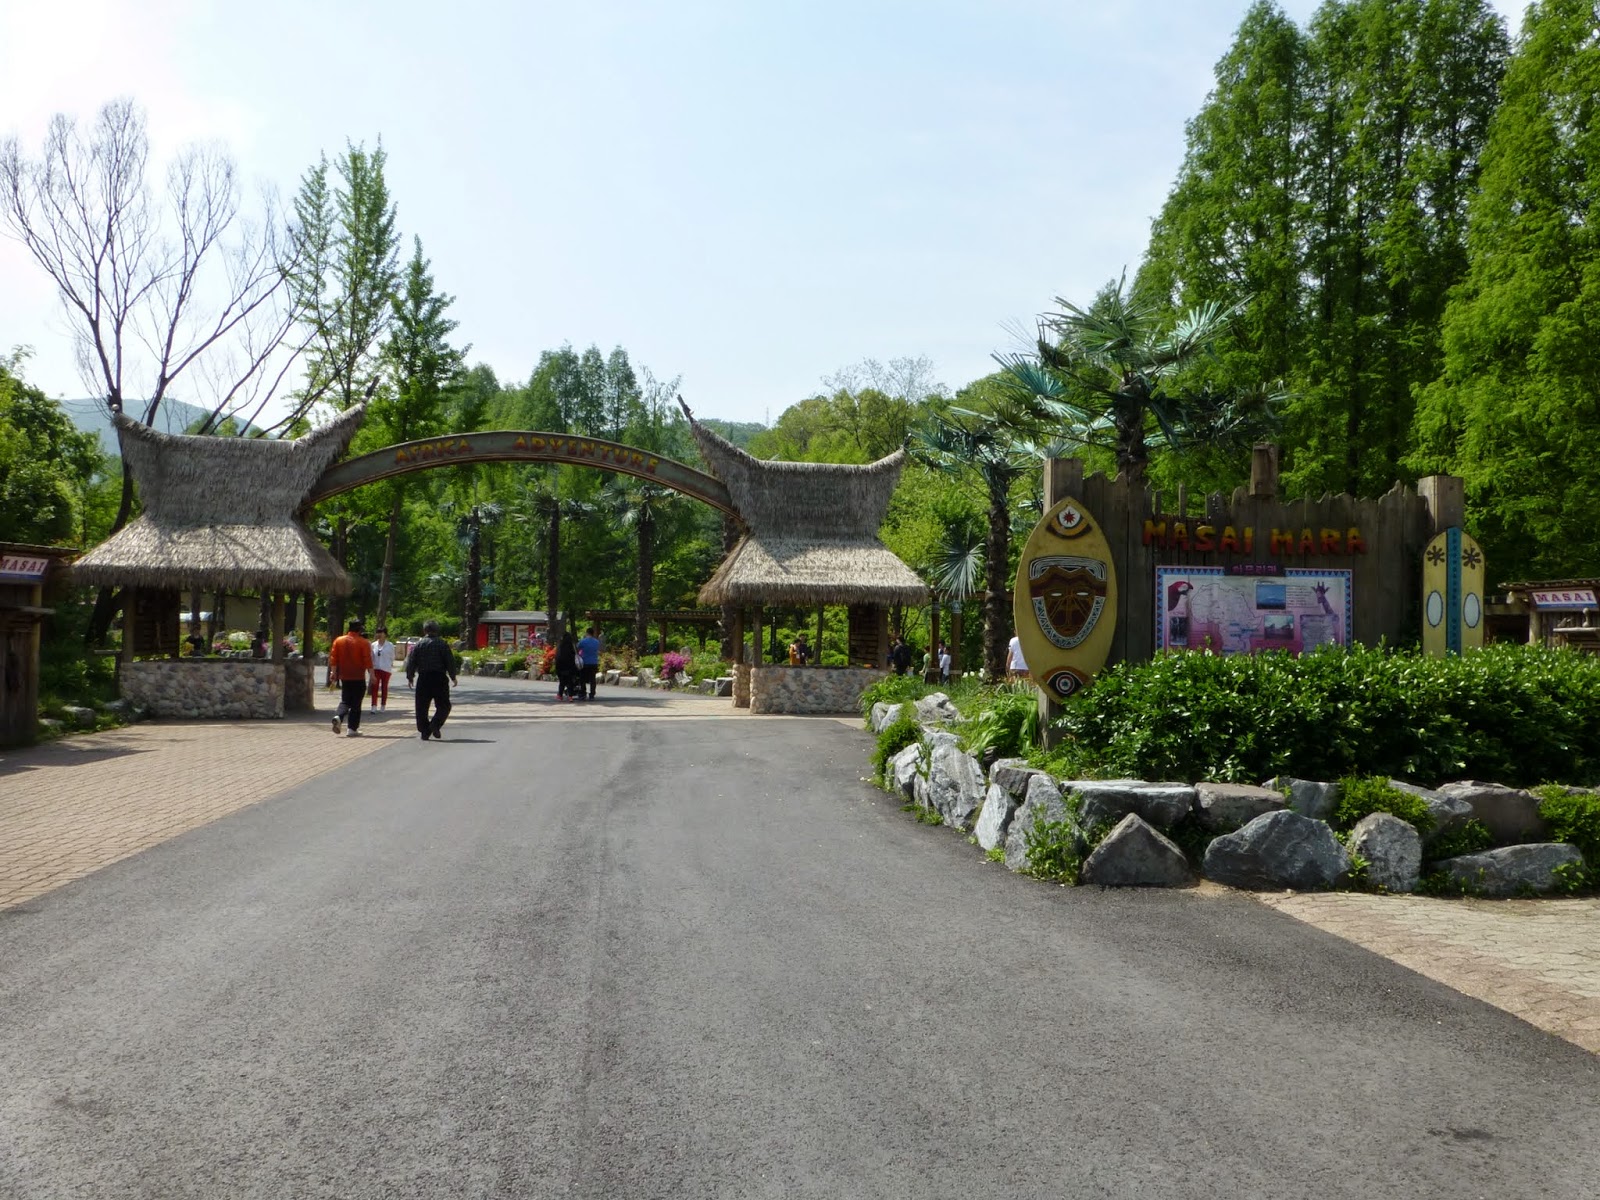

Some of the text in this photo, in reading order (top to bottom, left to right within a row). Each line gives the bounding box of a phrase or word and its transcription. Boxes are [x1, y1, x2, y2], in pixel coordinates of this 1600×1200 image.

[395, 435, 660, 474] AFRICA ADVENTURE
[1142, 519, 1368, 556] MASAI MARA
[1535, 592, 1594, 603] MASAI
